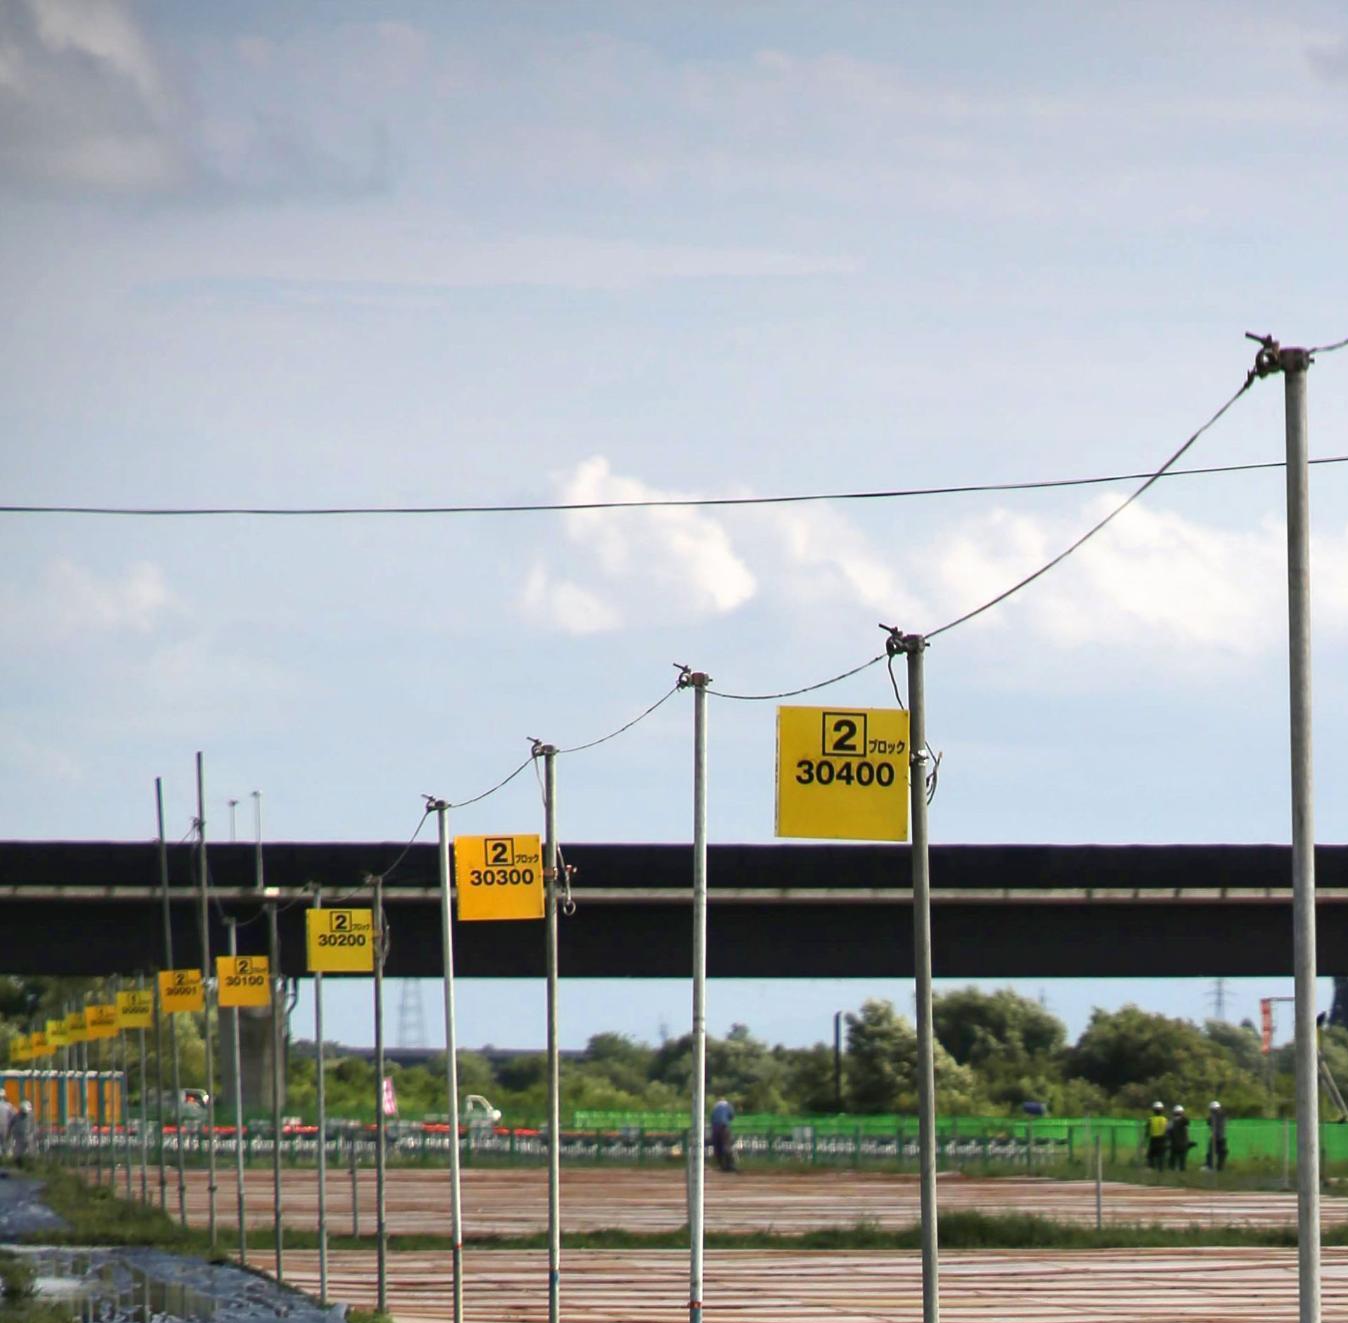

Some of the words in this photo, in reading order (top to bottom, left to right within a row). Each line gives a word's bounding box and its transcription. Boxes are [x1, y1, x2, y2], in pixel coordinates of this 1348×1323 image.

[832, 719, 858, 752] 2
[868, 738, 906, 755] ブロック
[795, 759, 895, 787] 30400
[492, 842, 508, 864] 2
[515, 854, 539, 864] ブロック
[469, 868, 535, 887] 30300
[334, 914, 348, 930] 2
[318, 934, 366, 947] 30200
[238, 960, 249, 973] 2
[225, 975, 265, 987] 30100
